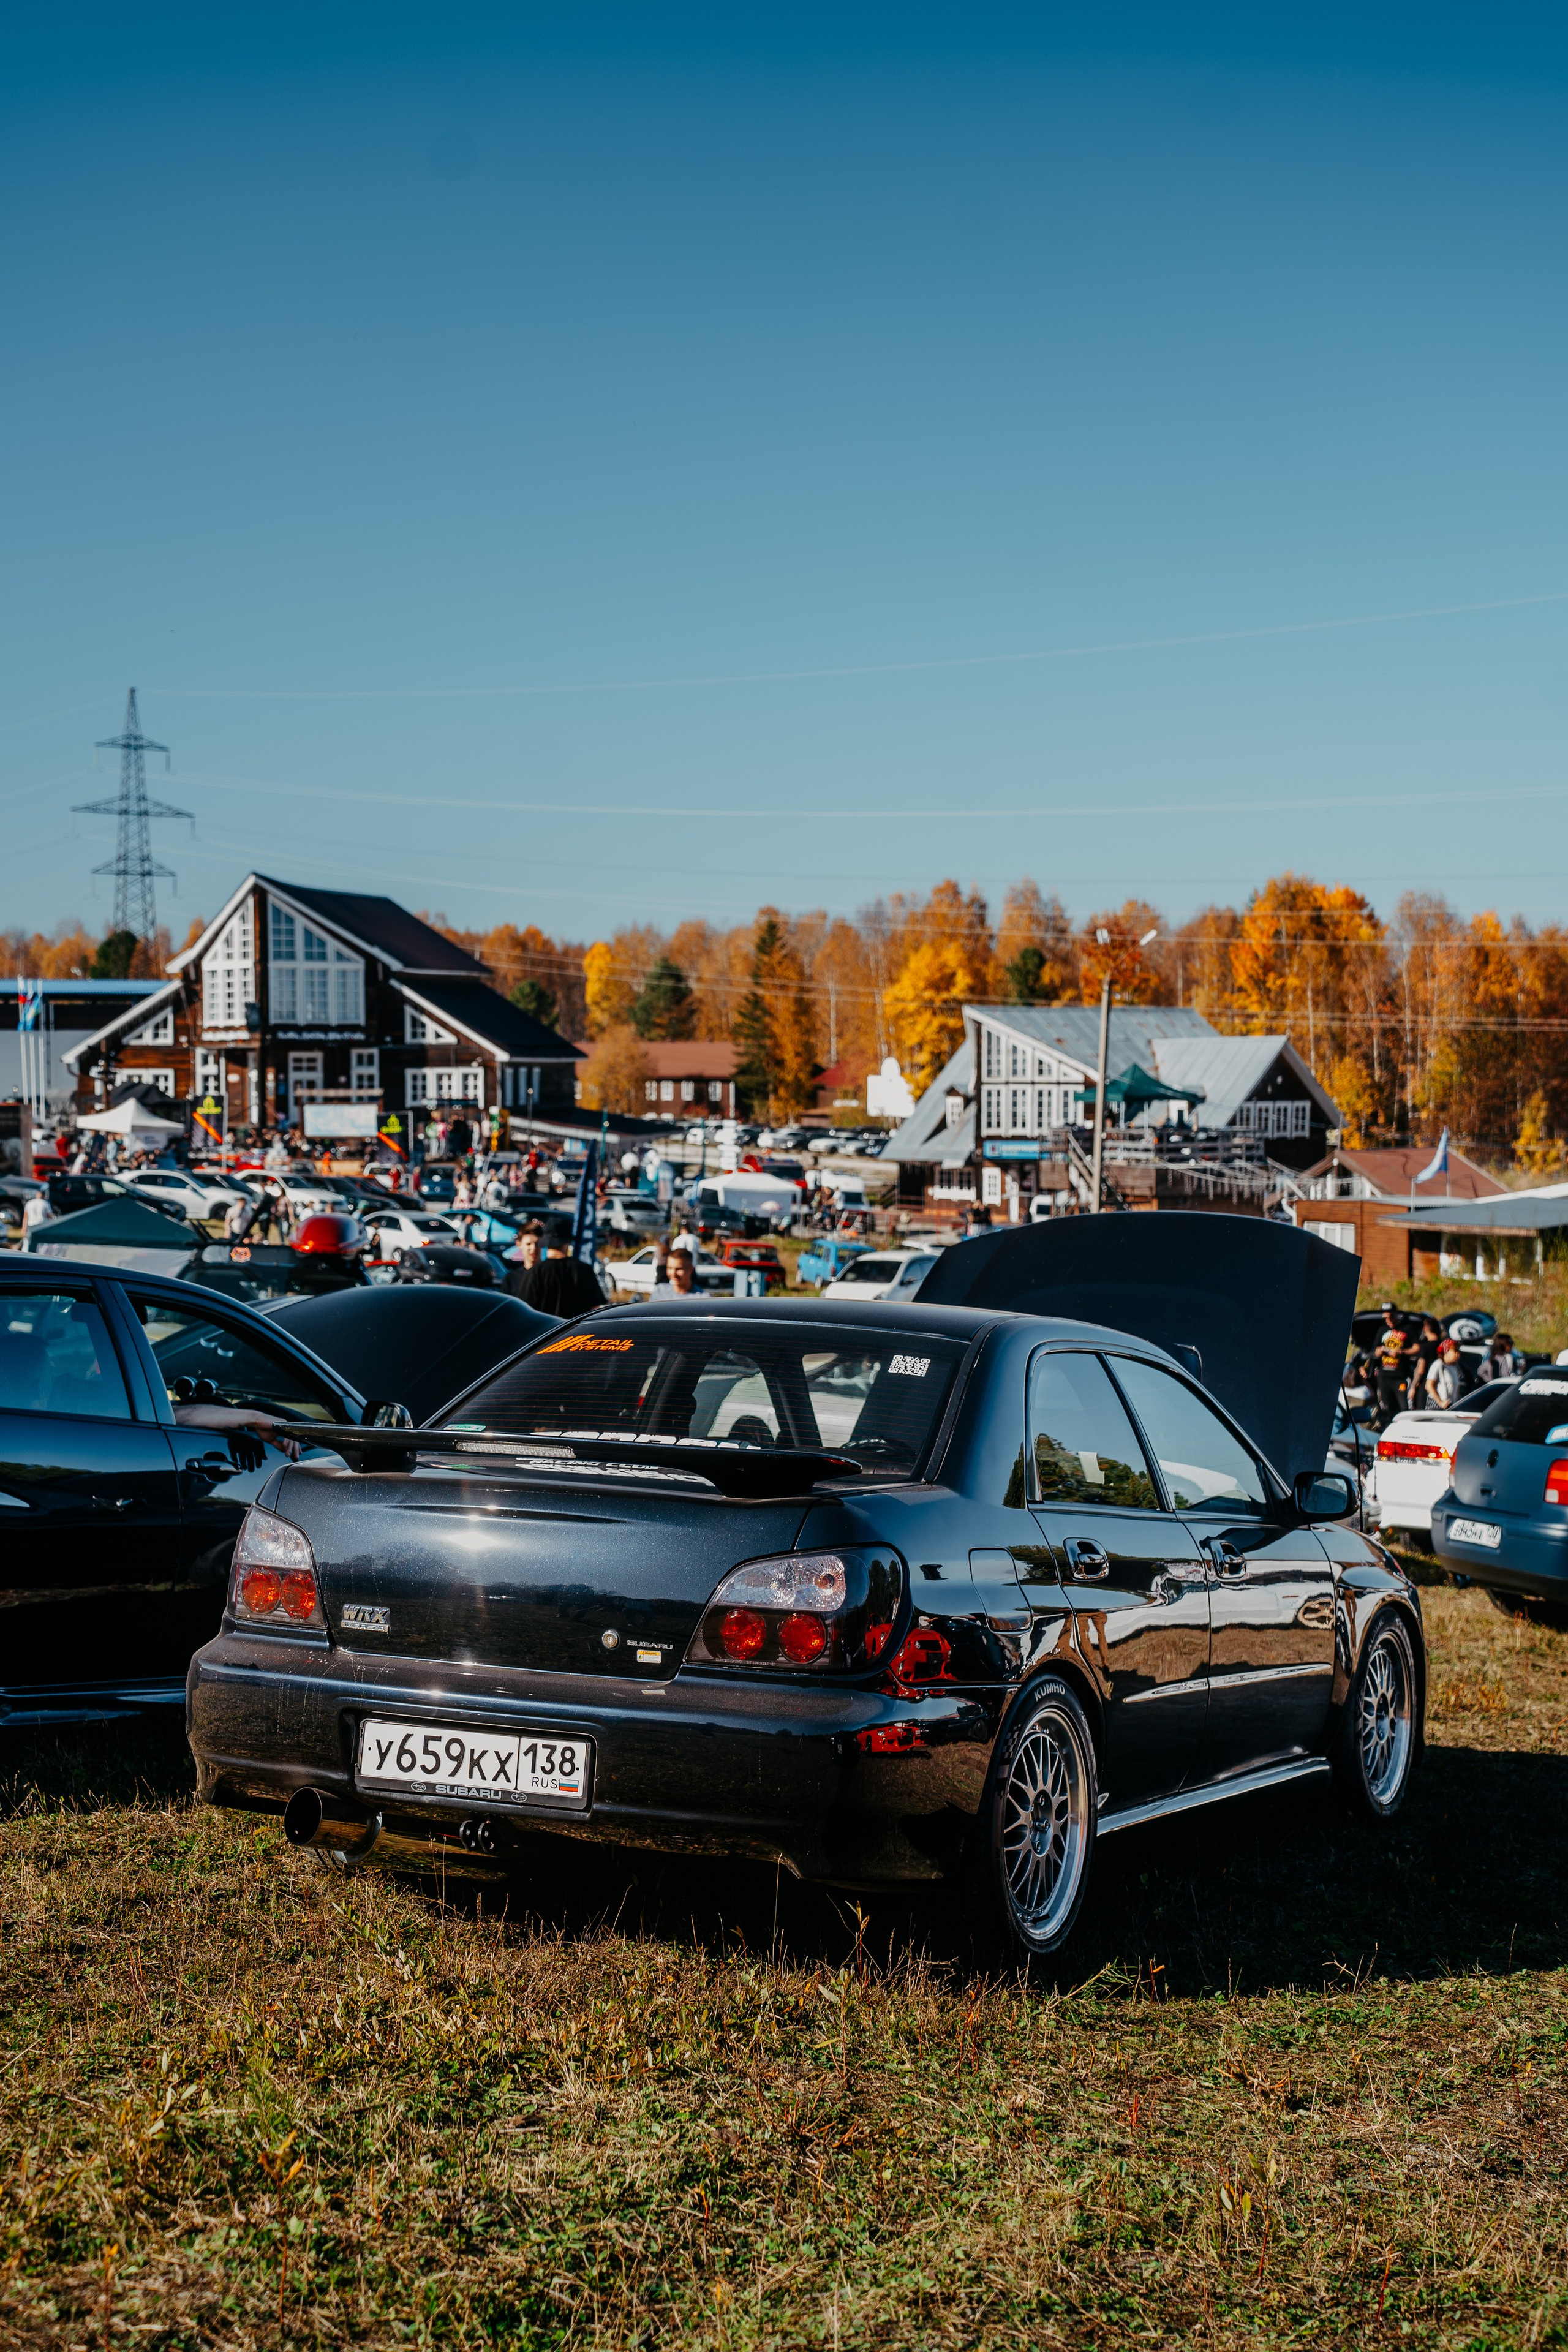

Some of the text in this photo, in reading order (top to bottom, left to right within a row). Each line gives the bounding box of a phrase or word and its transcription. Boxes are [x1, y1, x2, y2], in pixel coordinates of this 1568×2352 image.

[344, 1605, 389, 1624] WRX
[627, 1639, 673, 1650] SUBARU
[1034, 1683, 1066, 1702] KUMHO
[522, 1743, 576, 1777] 138
[435, 1784, 502, 1800] SUBARU
[532, 1777, 558, 1790] RUS
